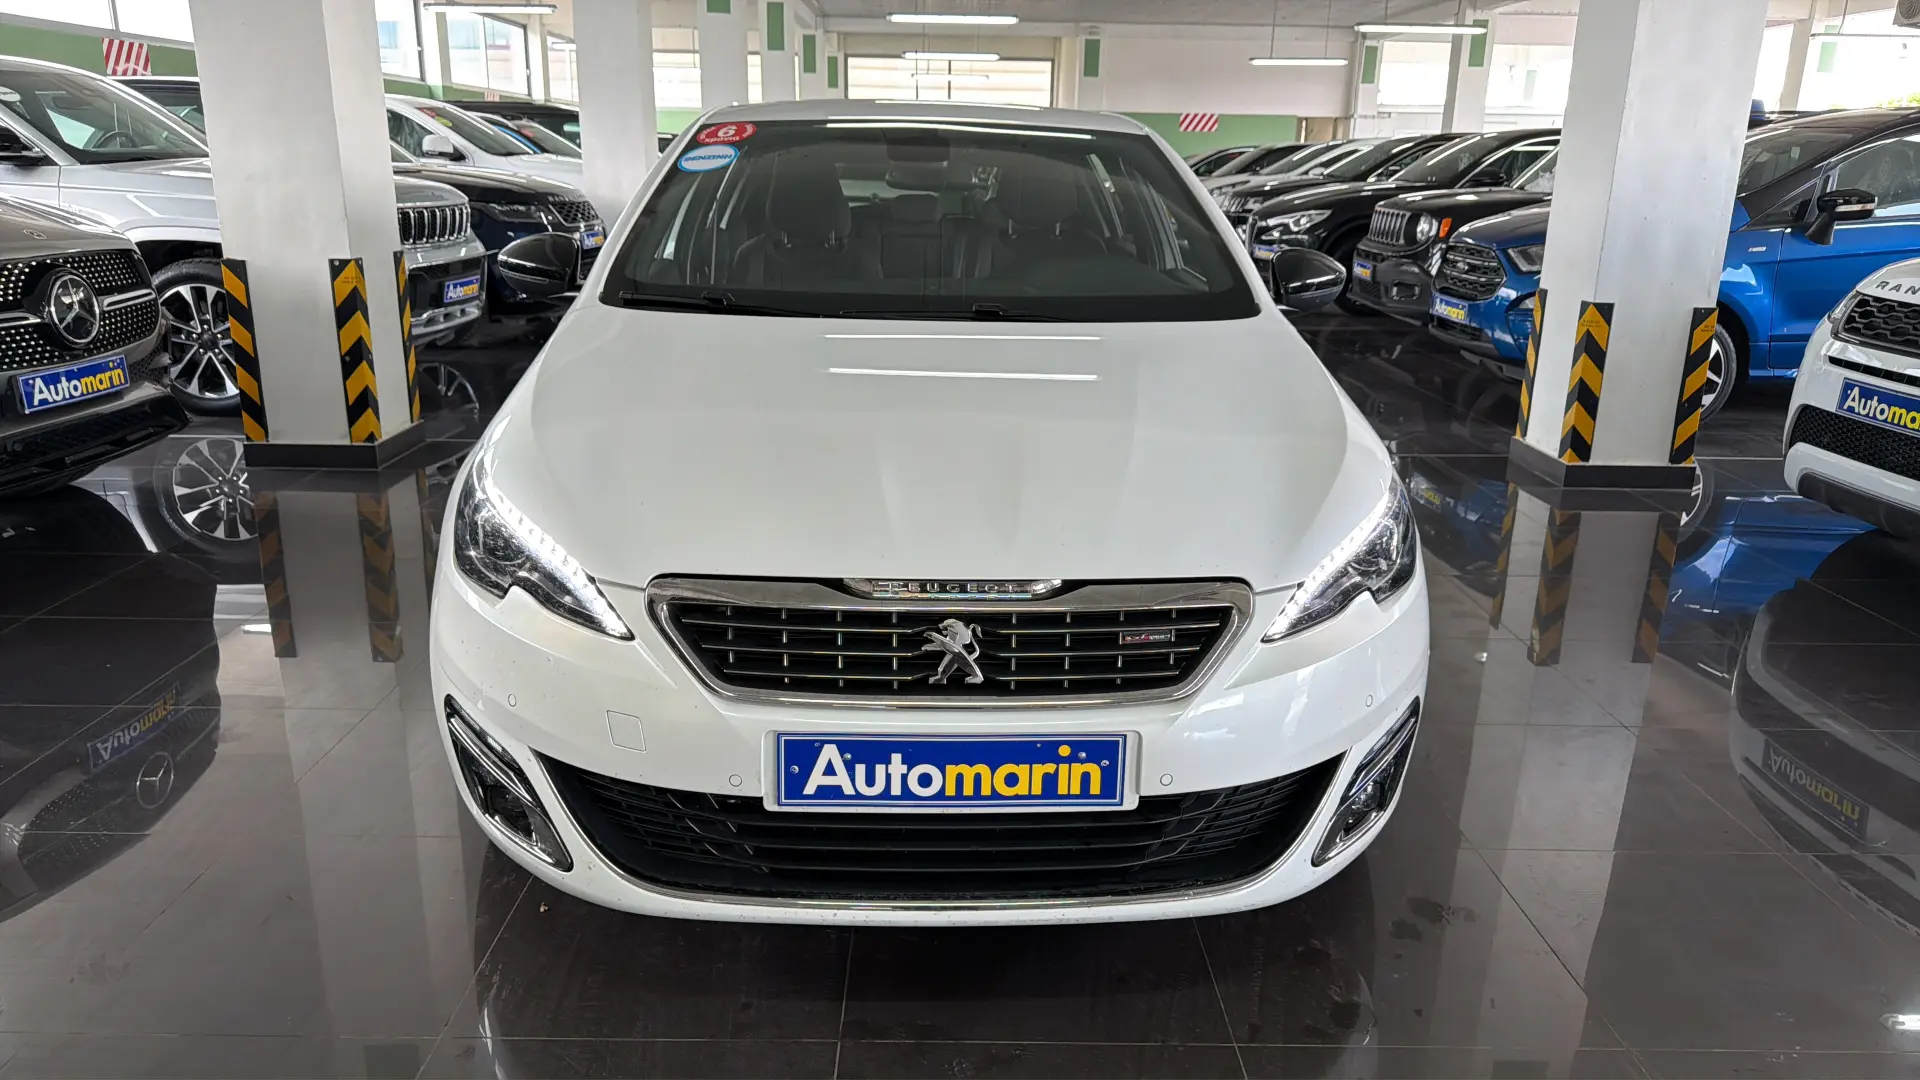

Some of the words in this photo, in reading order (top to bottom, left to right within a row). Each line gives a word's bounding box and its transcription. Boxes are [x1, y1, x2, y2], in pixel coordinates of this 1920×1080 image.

[717, 125, 738, 138] 6
[33, 361, 125, 406] Automarin
[888, 582, 1018, 593] PEUGEOT
[802, 743, 1101, 797] Automarin
